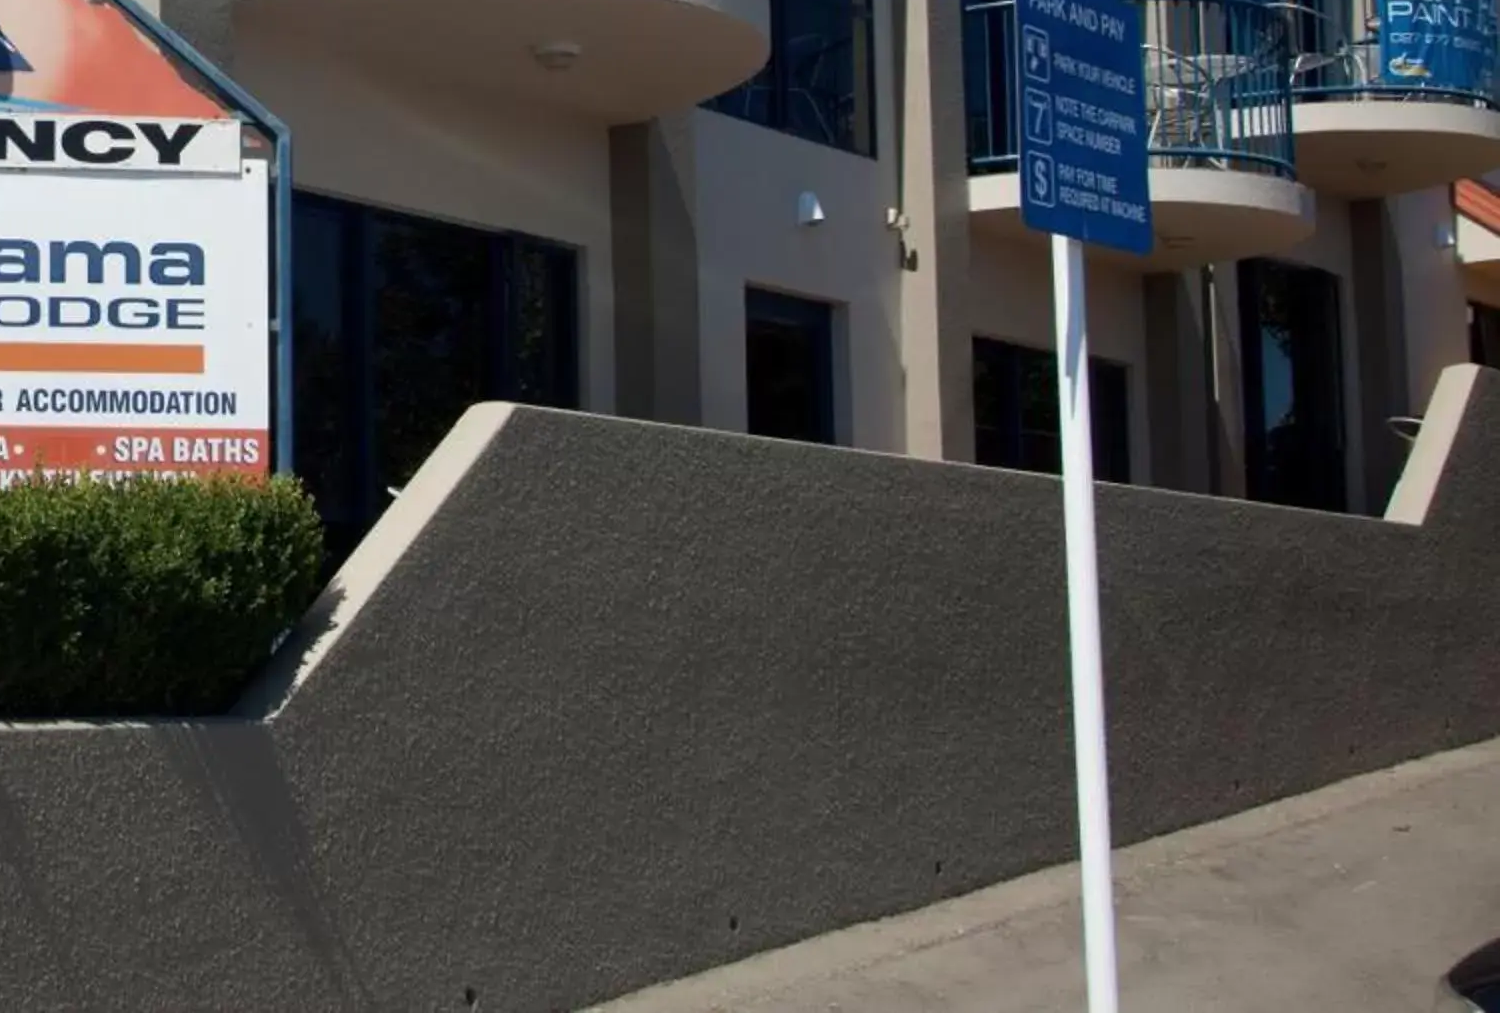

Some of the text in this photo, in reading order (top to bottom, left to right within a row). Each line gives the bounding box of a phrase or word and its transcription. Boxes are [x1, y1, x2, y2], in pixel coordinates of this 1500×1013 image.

[1069, 2, 1099, 32] AND
[1101, 13, 1125, 42] PAY
[1053, 52, 1077, 76] PARK
[1055, 95, 1079, 118] NOTE
[1080, 102, 1097, 123] THE
[1057, 121, 1121, 155] SPACE NUMBER
[1058, 163, 1119, 195] PAY FOR TIME
[16, 389, 237, 416] ACCOMMODATION
[114, 437, 166, 463] SPA
[173, 438, 260, 464] BATHS
